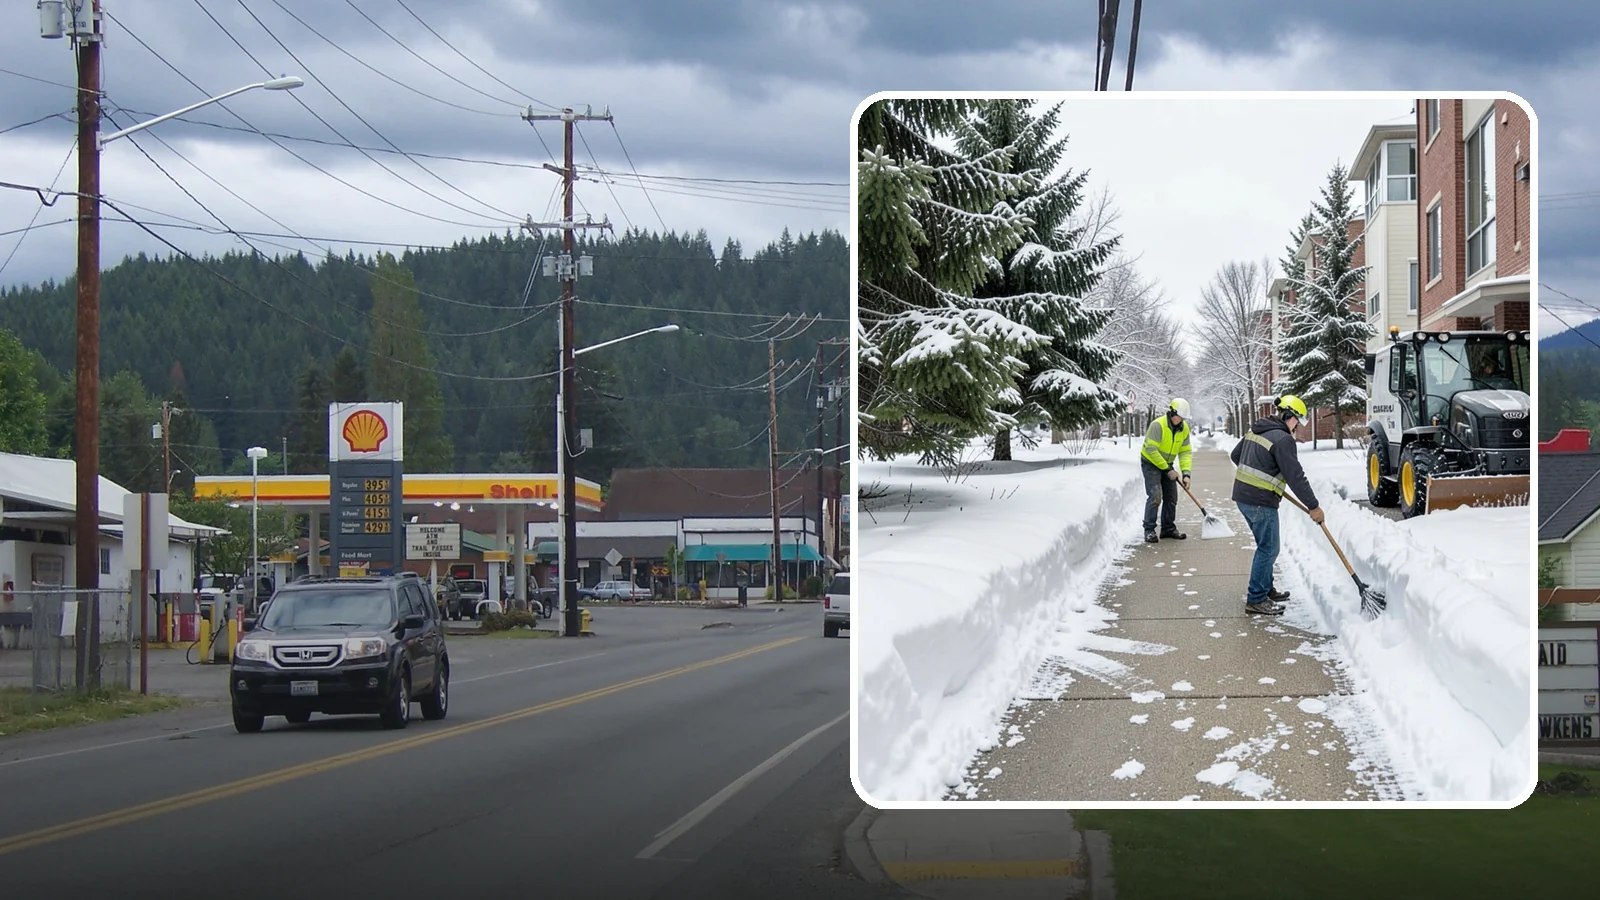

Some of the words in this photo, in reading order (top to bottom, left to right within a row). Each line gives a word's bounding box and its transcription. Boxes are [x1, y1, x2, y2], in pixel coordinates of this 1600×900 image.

[366, 480, 383, 490] 395
[490, 484, 547, 499] Shell
[366, 494, 383, 504] 405
[366, 508, 383, 518] 415
[366, 522, 383, 532] 429
